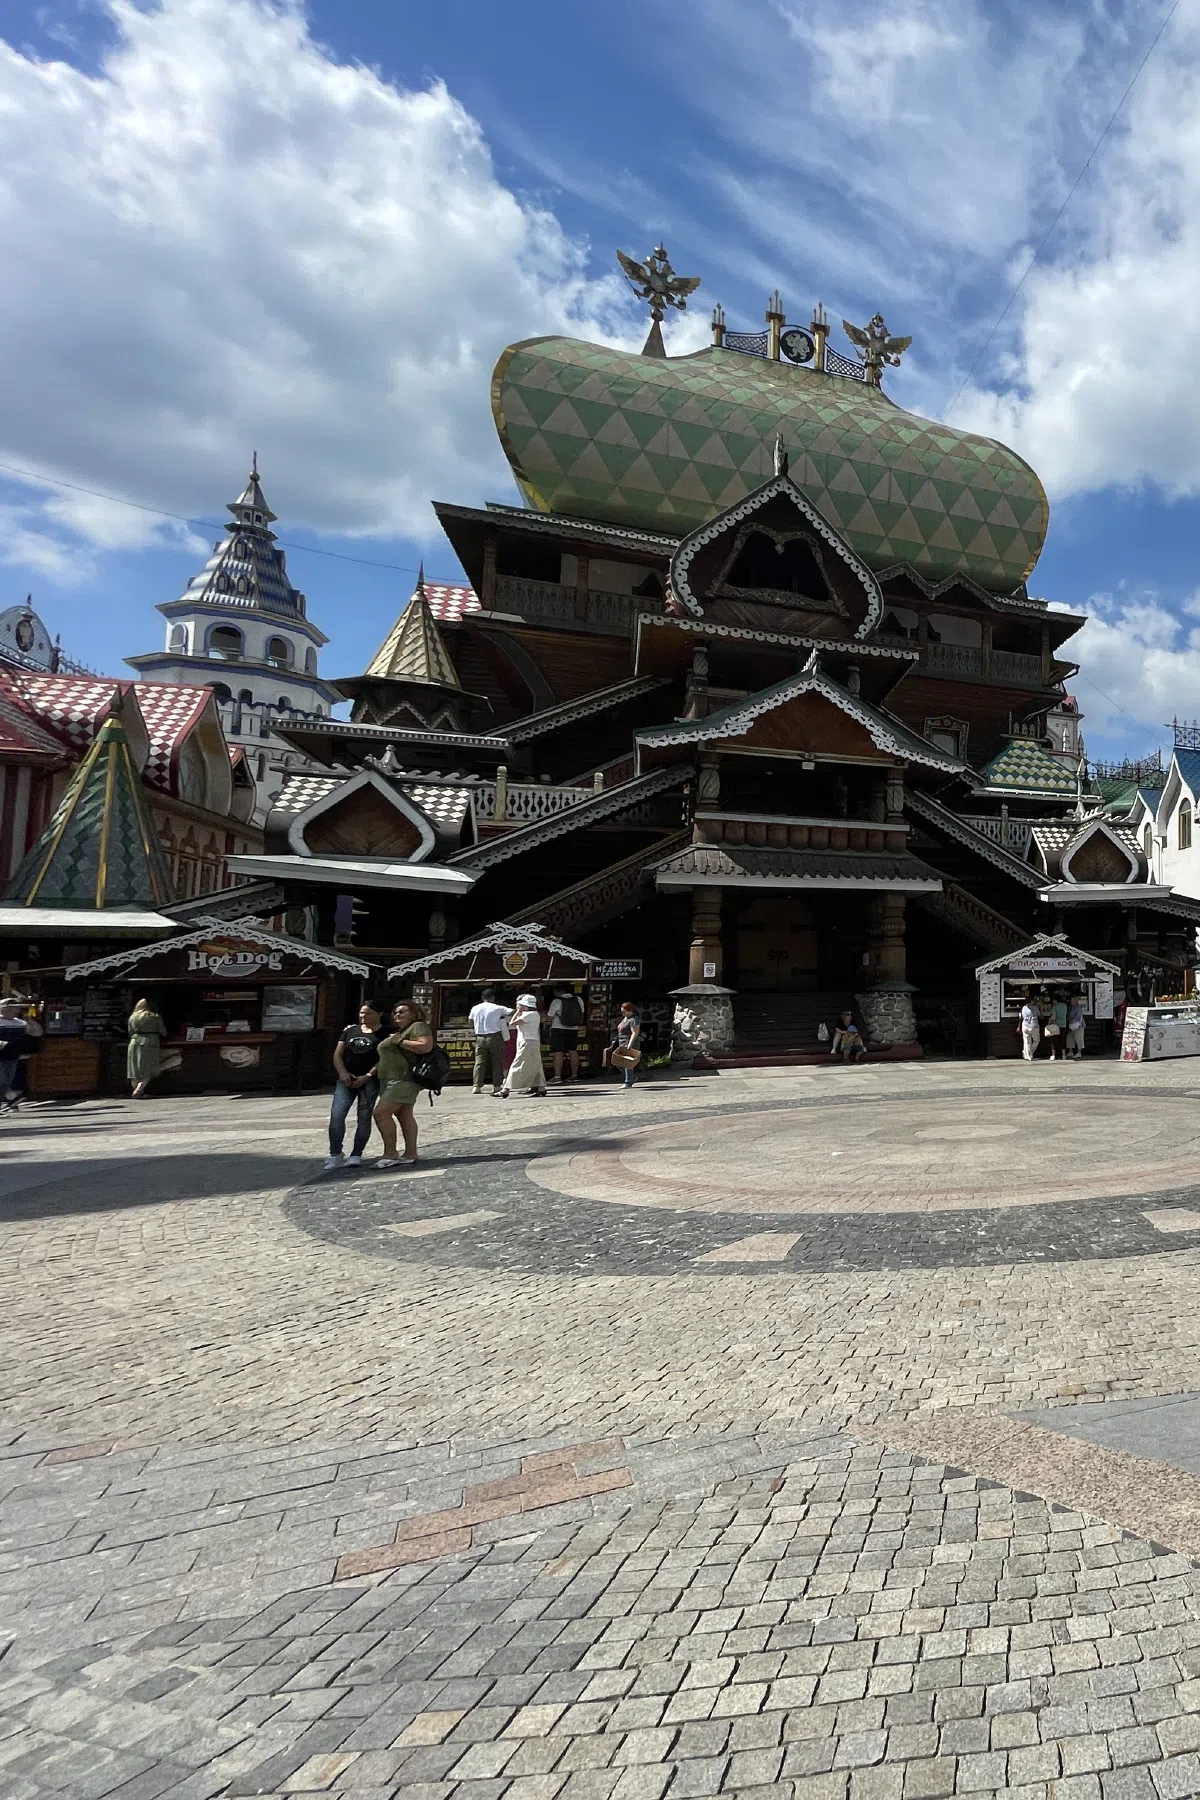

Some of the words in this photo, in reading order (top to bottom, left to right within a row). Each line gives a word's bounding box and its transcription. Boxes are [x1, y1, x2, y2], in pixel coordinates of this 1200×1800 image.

[187, 950, 233, 971] Hot
[236, 952, 283, 970] Dog
[446, 1041, 471, 1050] МЁД
